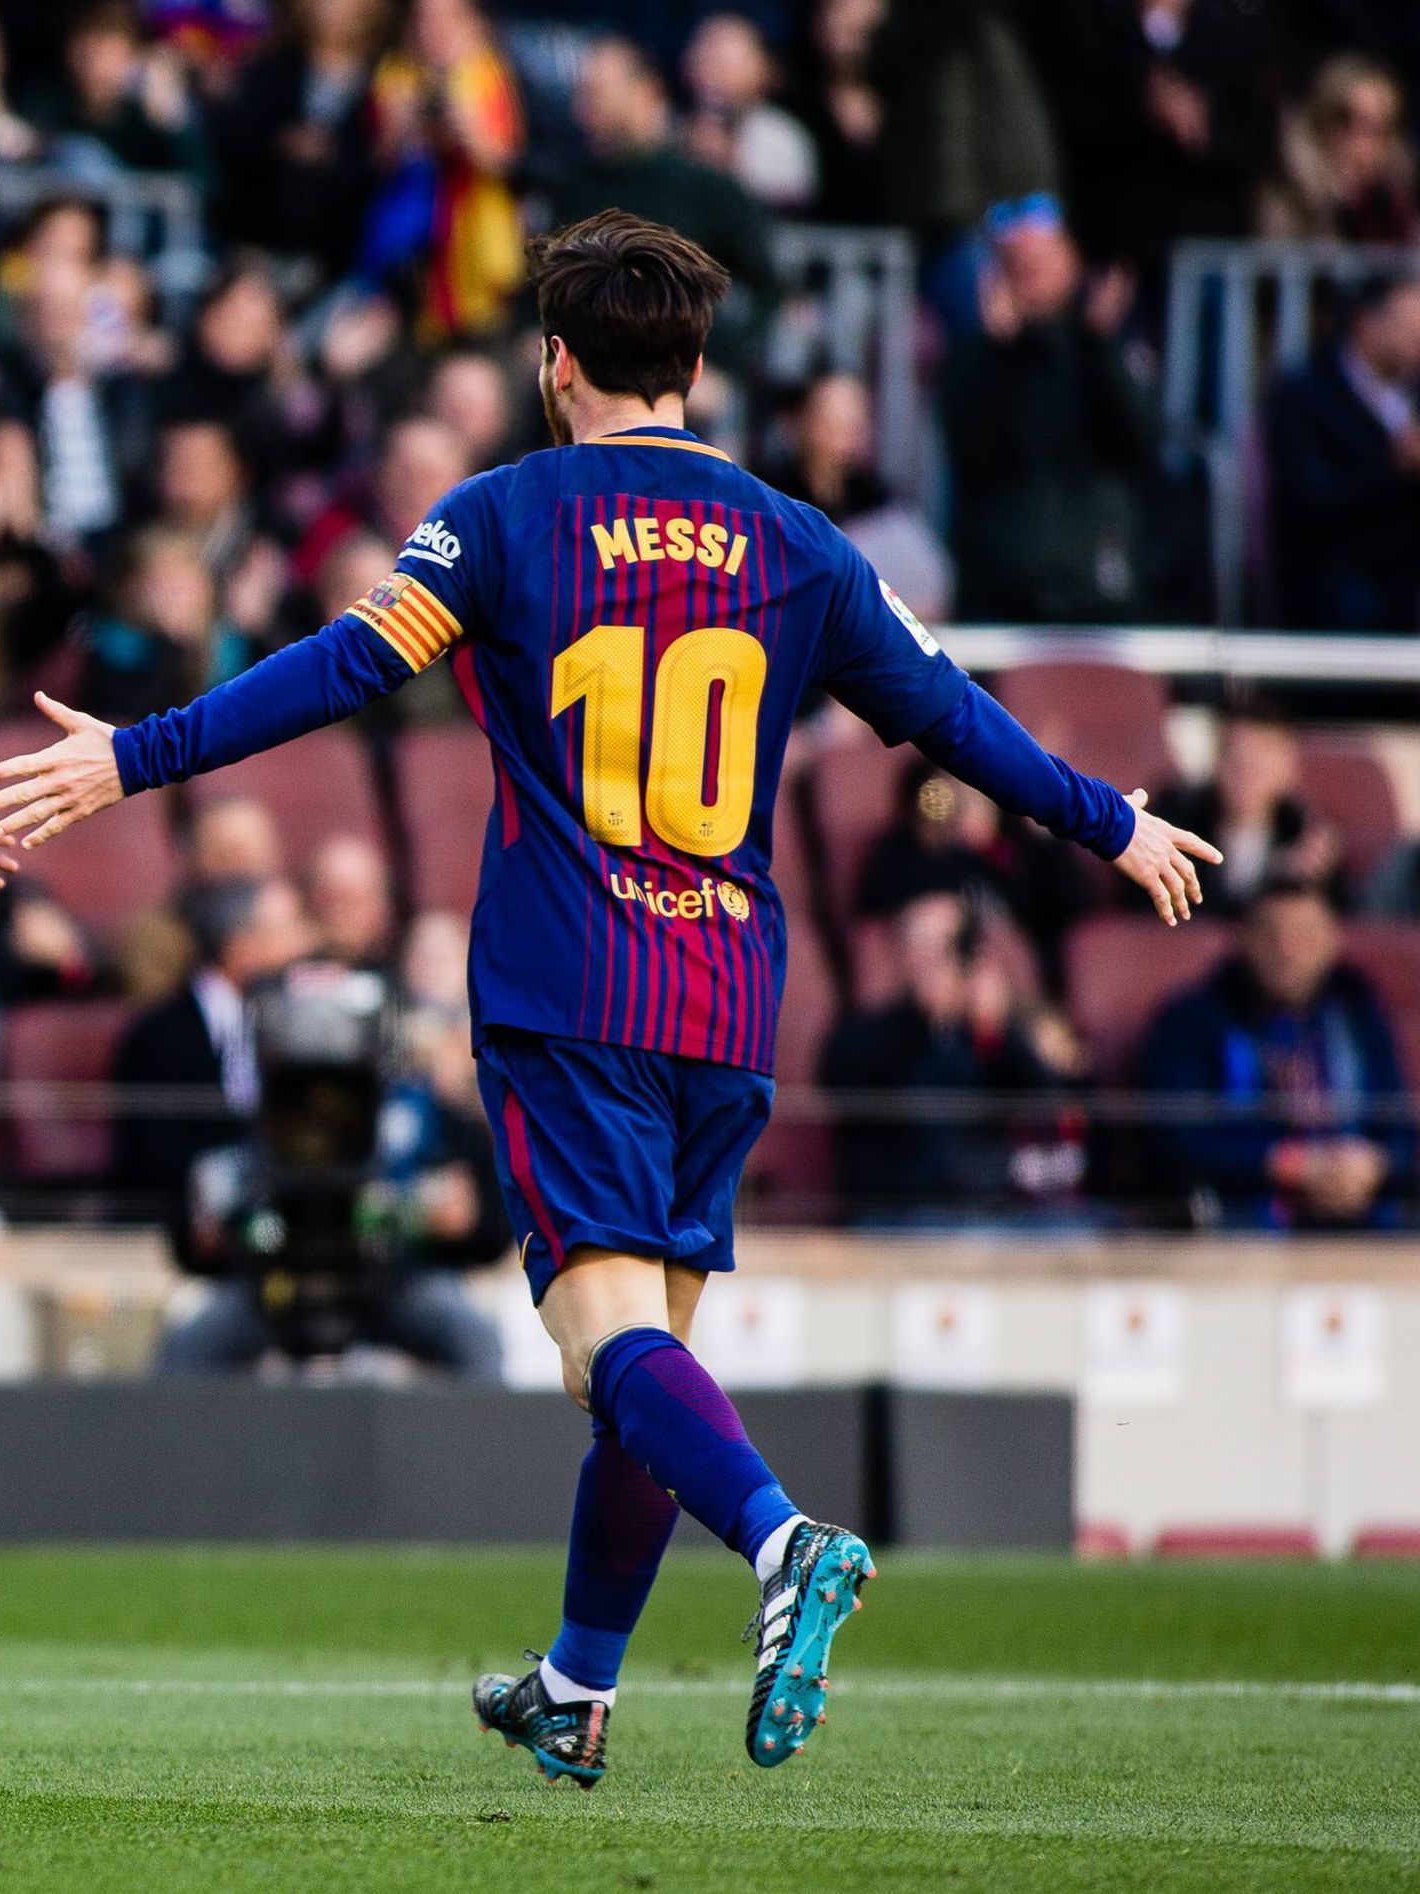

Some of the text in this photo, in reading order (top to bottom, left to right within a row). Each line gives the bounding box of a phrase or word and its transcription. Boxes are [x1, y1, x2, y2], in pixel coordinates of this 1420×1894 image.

[591, 517, 748, 576] MESSI
[551, 625, 768, 857] 10
[610, 873, 716, 920] unicef
